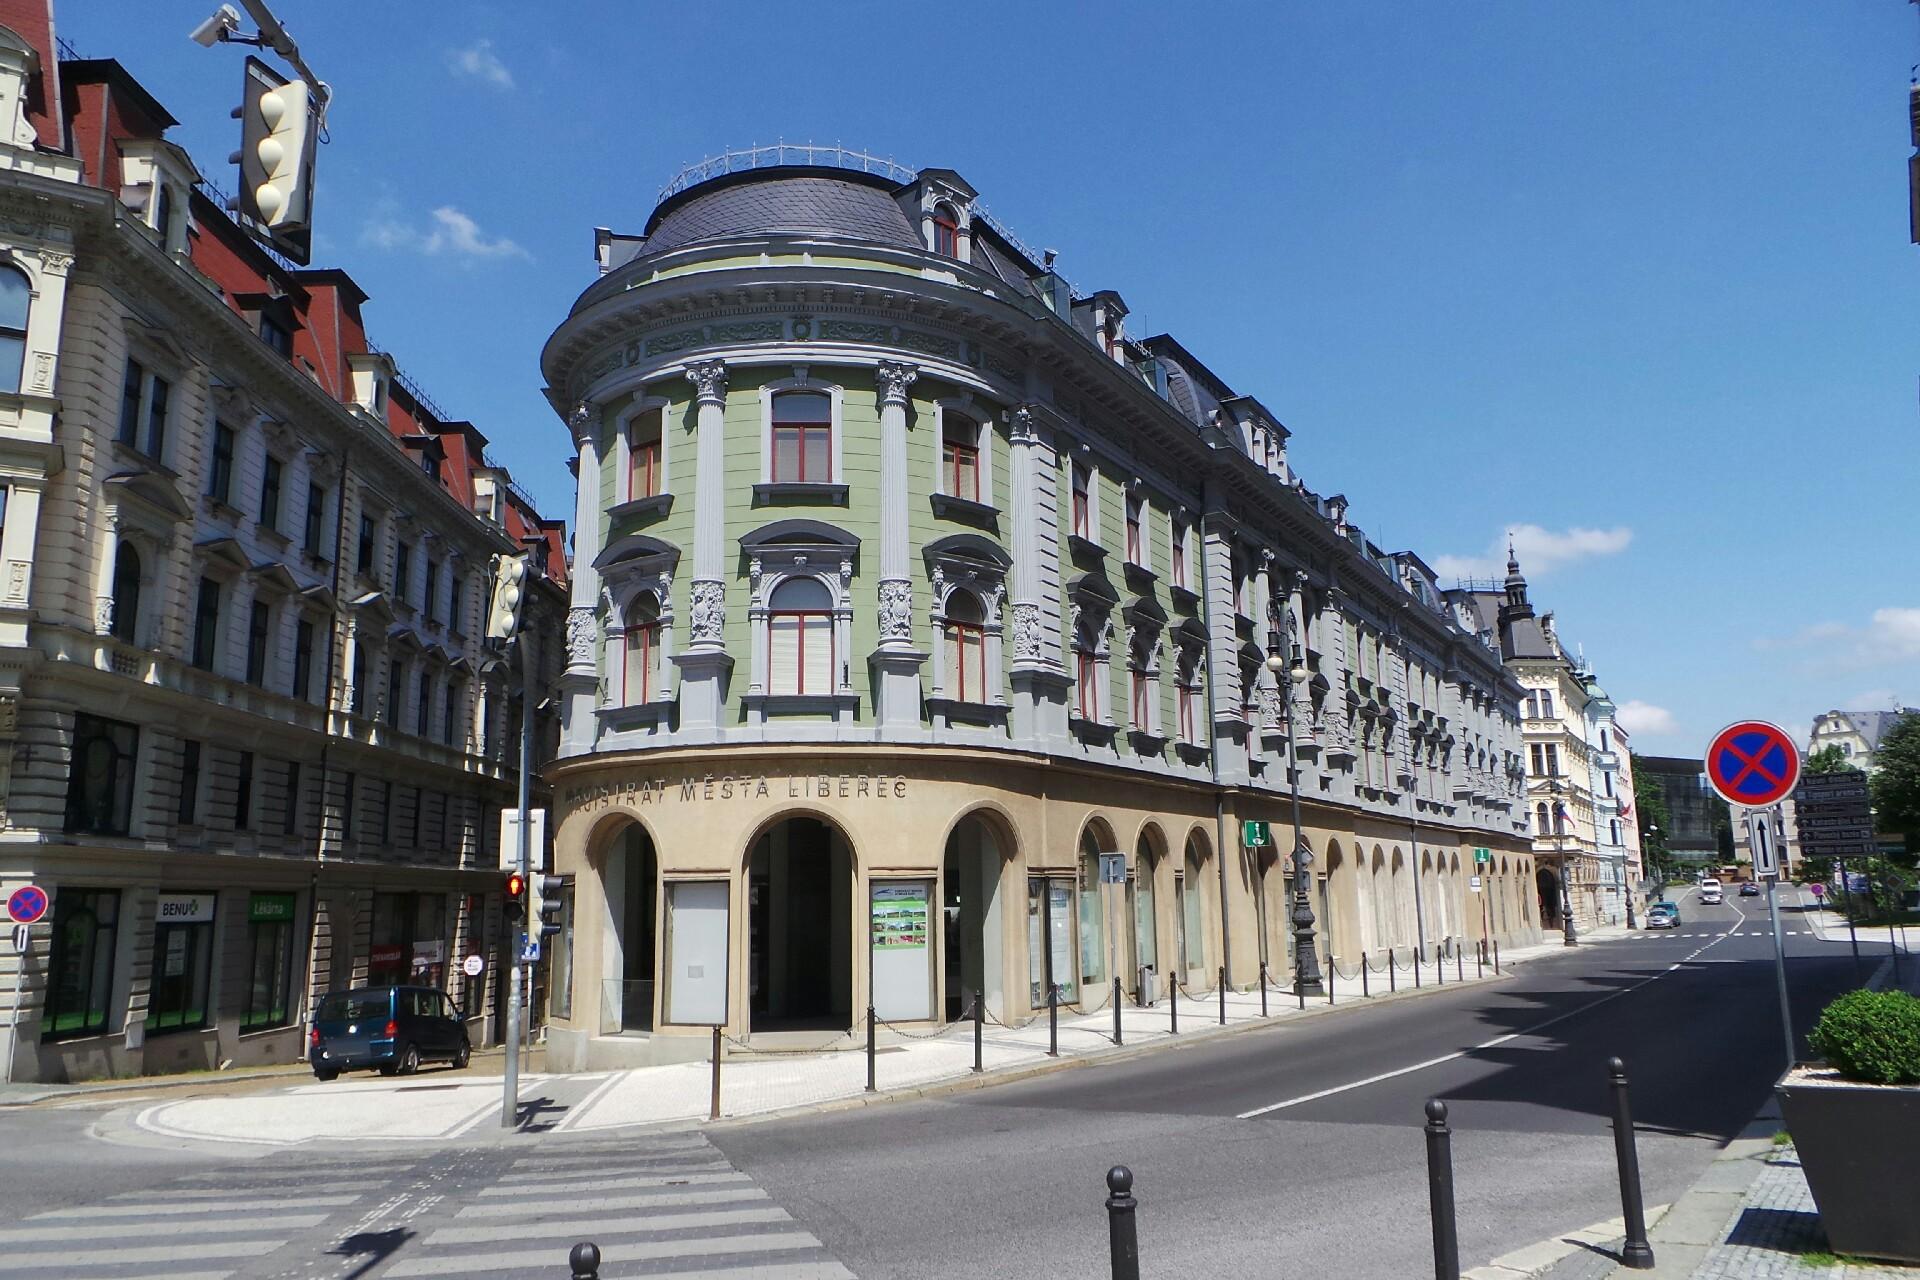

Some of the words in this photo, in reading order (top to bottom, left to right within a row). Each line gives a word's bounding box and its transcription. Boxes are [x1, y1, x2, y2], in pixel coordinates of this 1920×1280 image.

[680, 773, 769, 799] MĚSTA
[788, 774, 907, 798] LIBEREC
[163, 903, 189, 916] BENU
